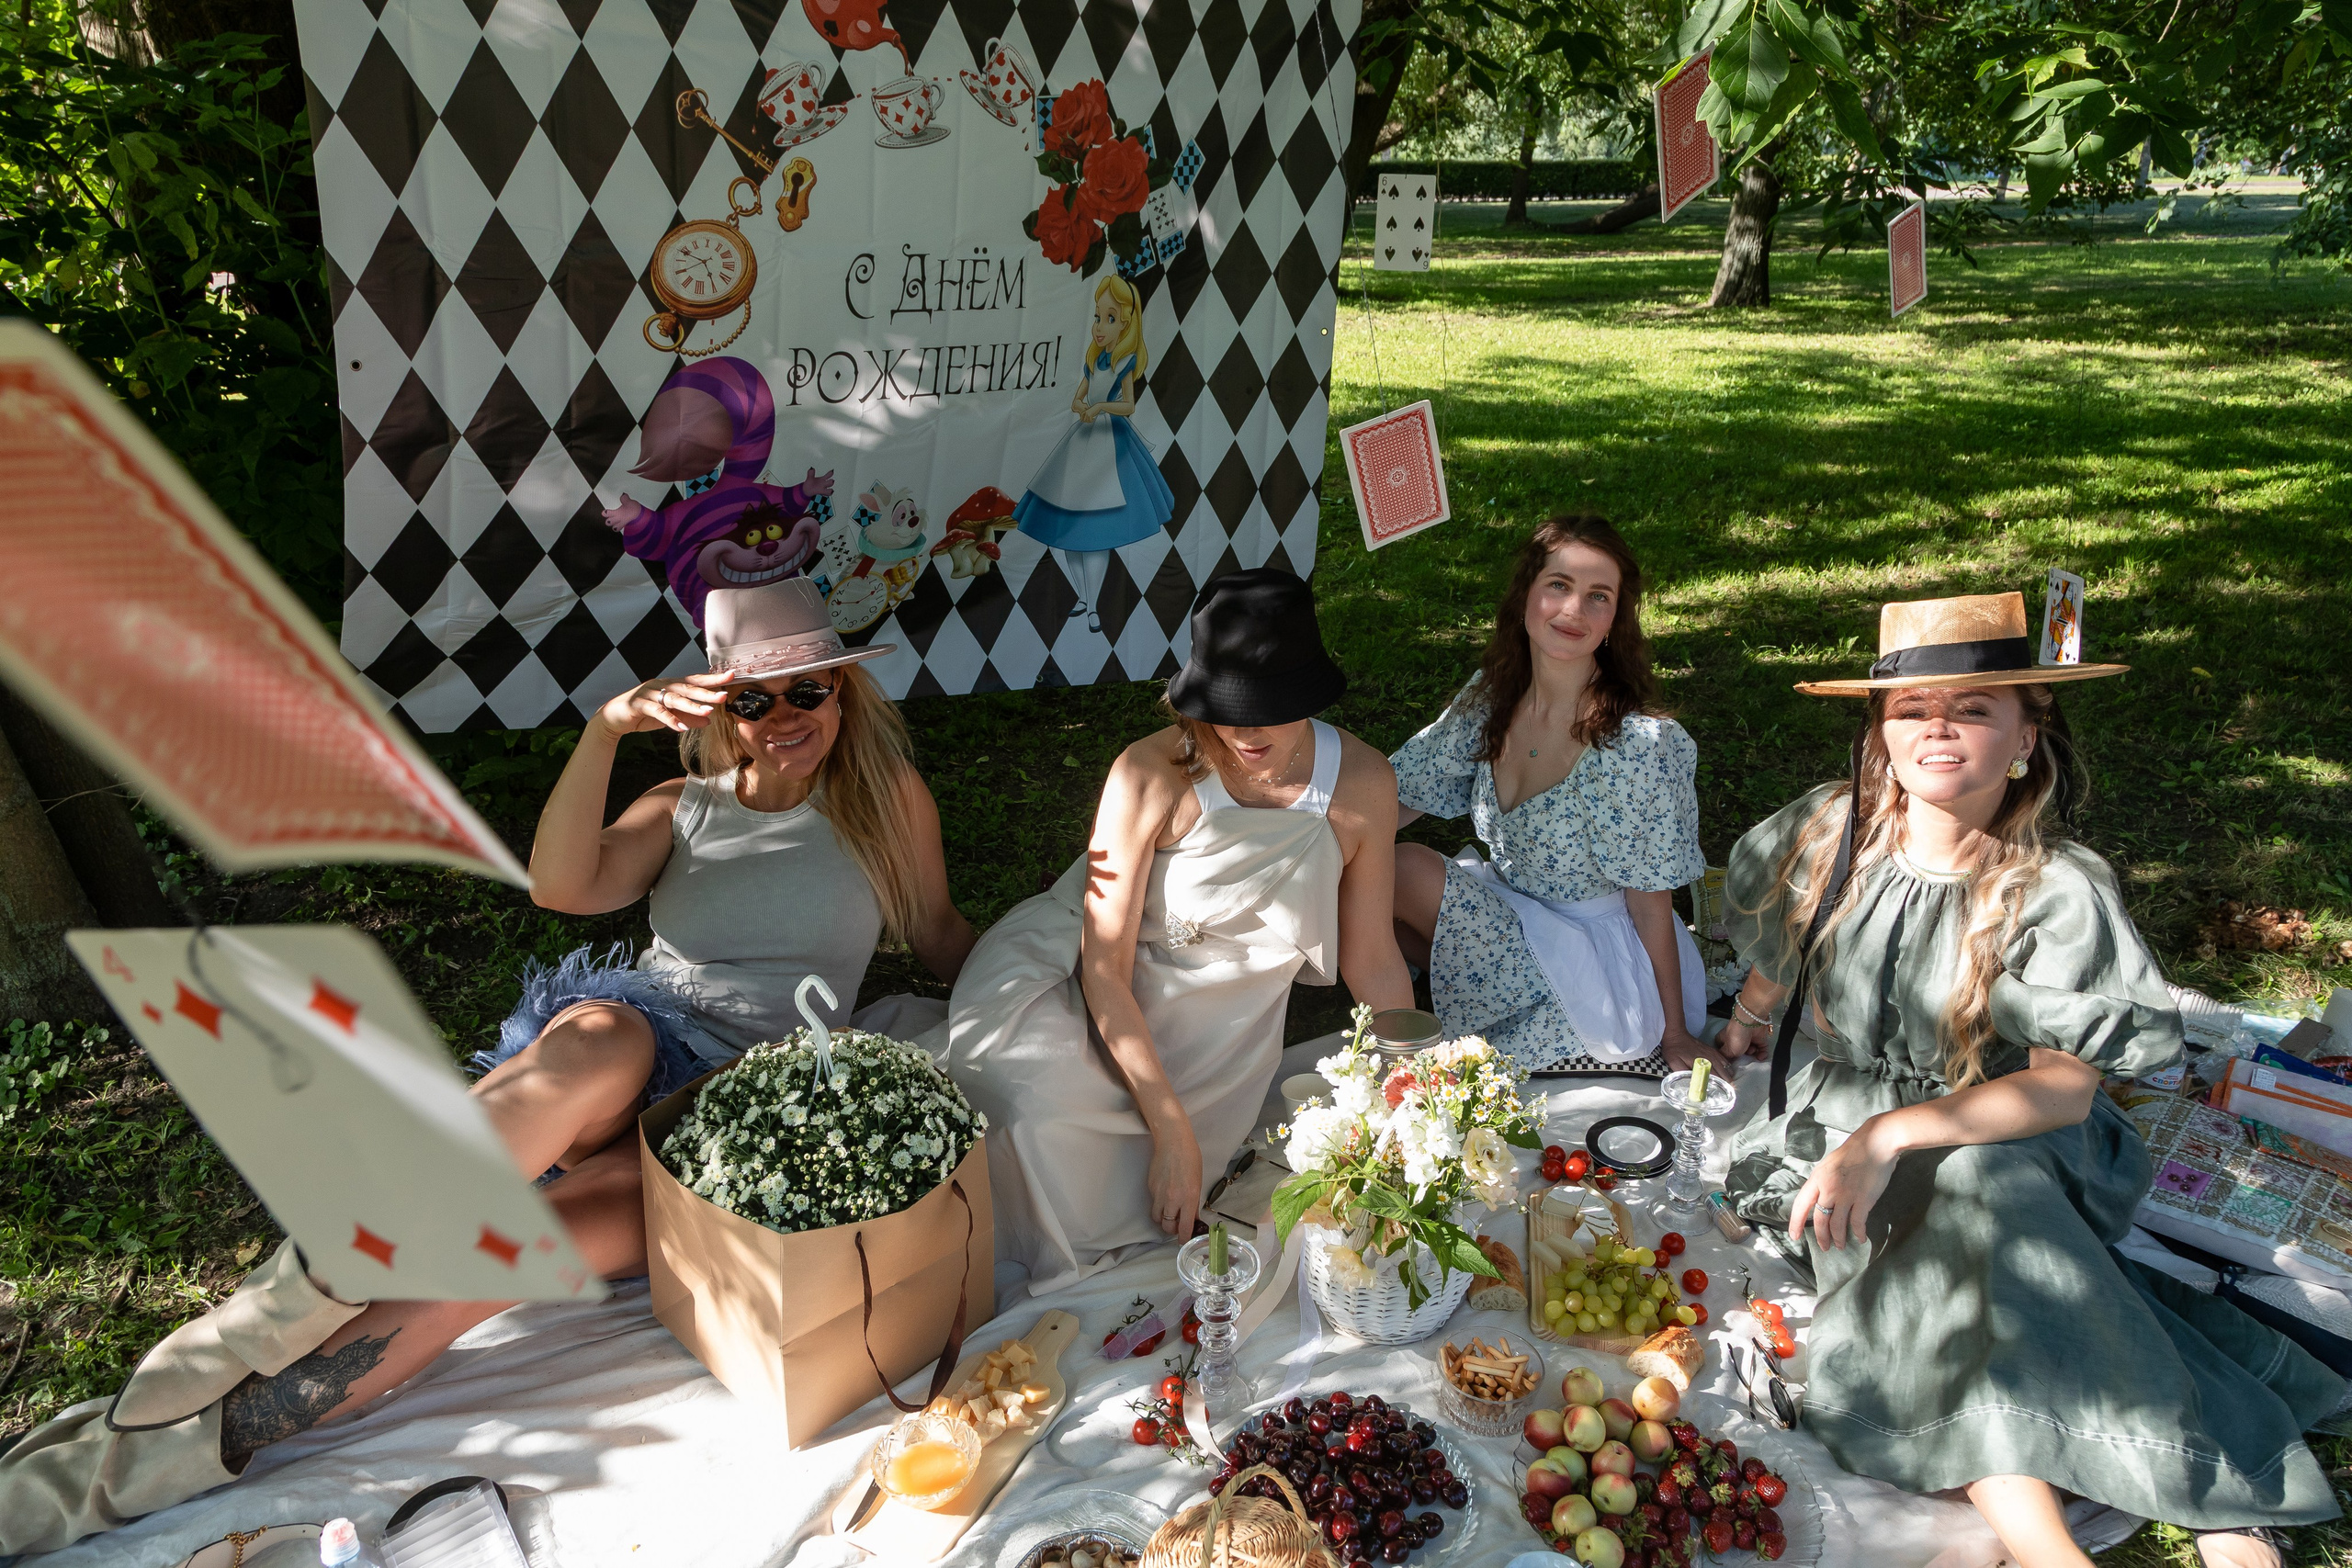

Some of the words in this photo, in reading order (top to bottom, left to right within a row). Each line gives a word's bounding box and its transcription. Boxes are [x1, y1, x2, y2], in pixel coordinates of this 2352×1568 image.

[1382, 176, 1387, 186] 6
[845, 253, 876, 320] С
[890, 243, 1026, 325] ДНЁМ
[786, 335, 1062, 406] РОЖДЕНИЯ!
